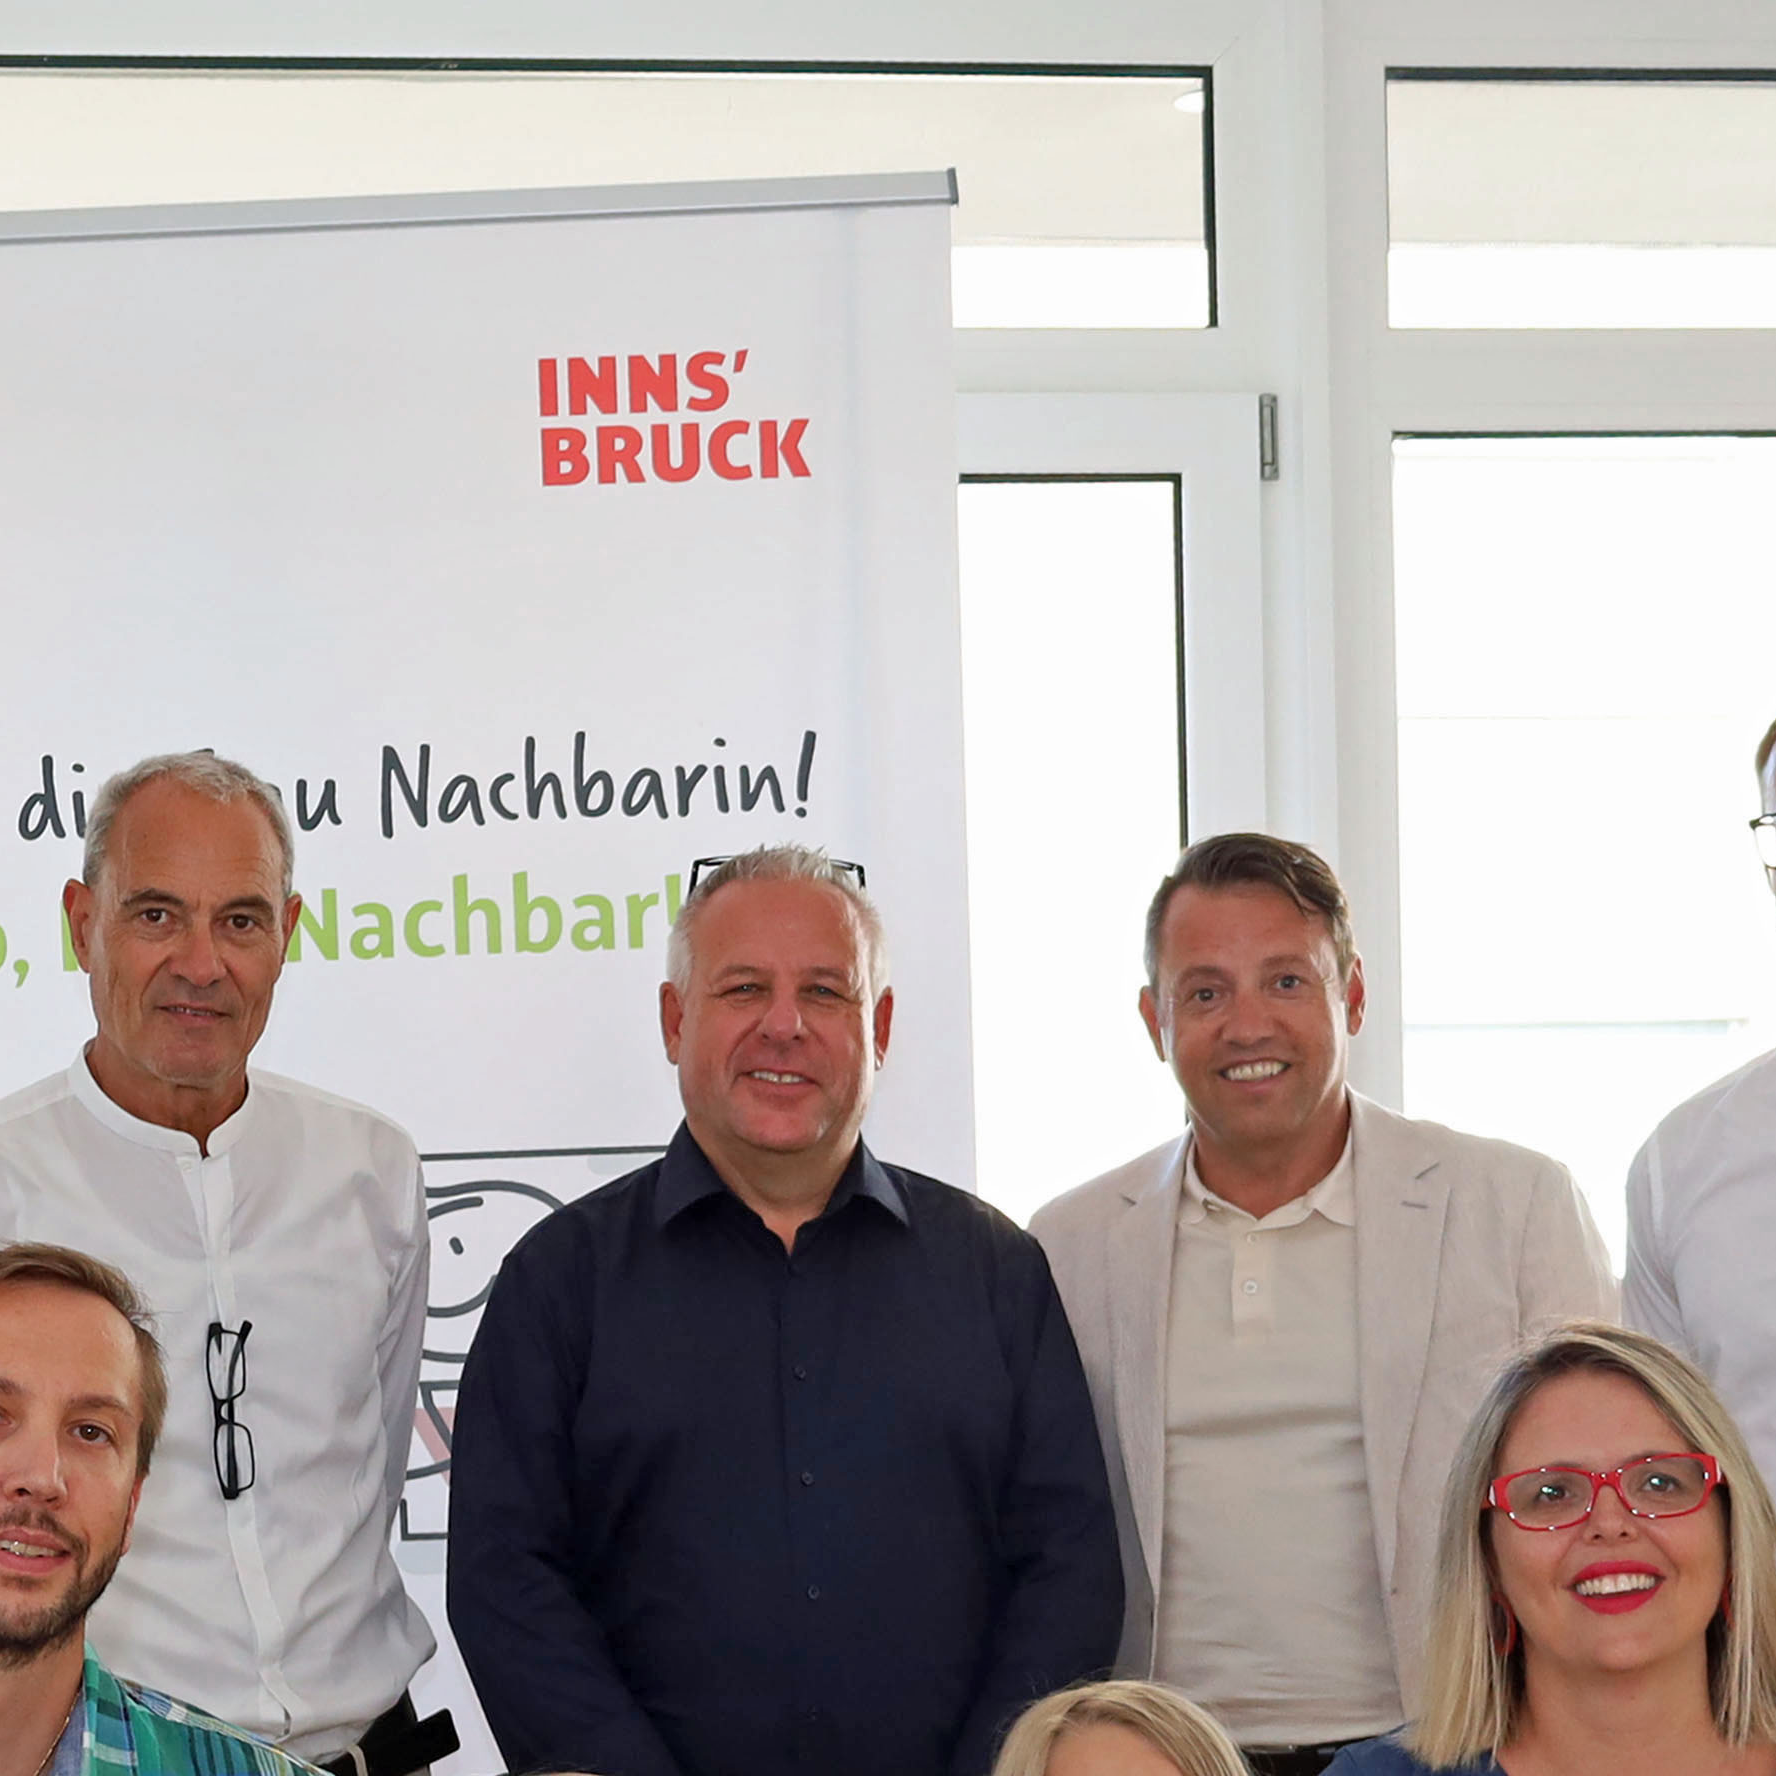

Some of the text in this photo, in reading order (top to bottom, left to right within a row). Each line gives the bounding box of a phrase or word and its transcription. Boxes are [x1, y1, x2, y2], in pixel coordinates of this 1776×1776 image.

[540, 350, 748, 416] INNS'
[542, 419, 811, 487] BRUCK
[382, 731, 817, 839] Nachbarin!
